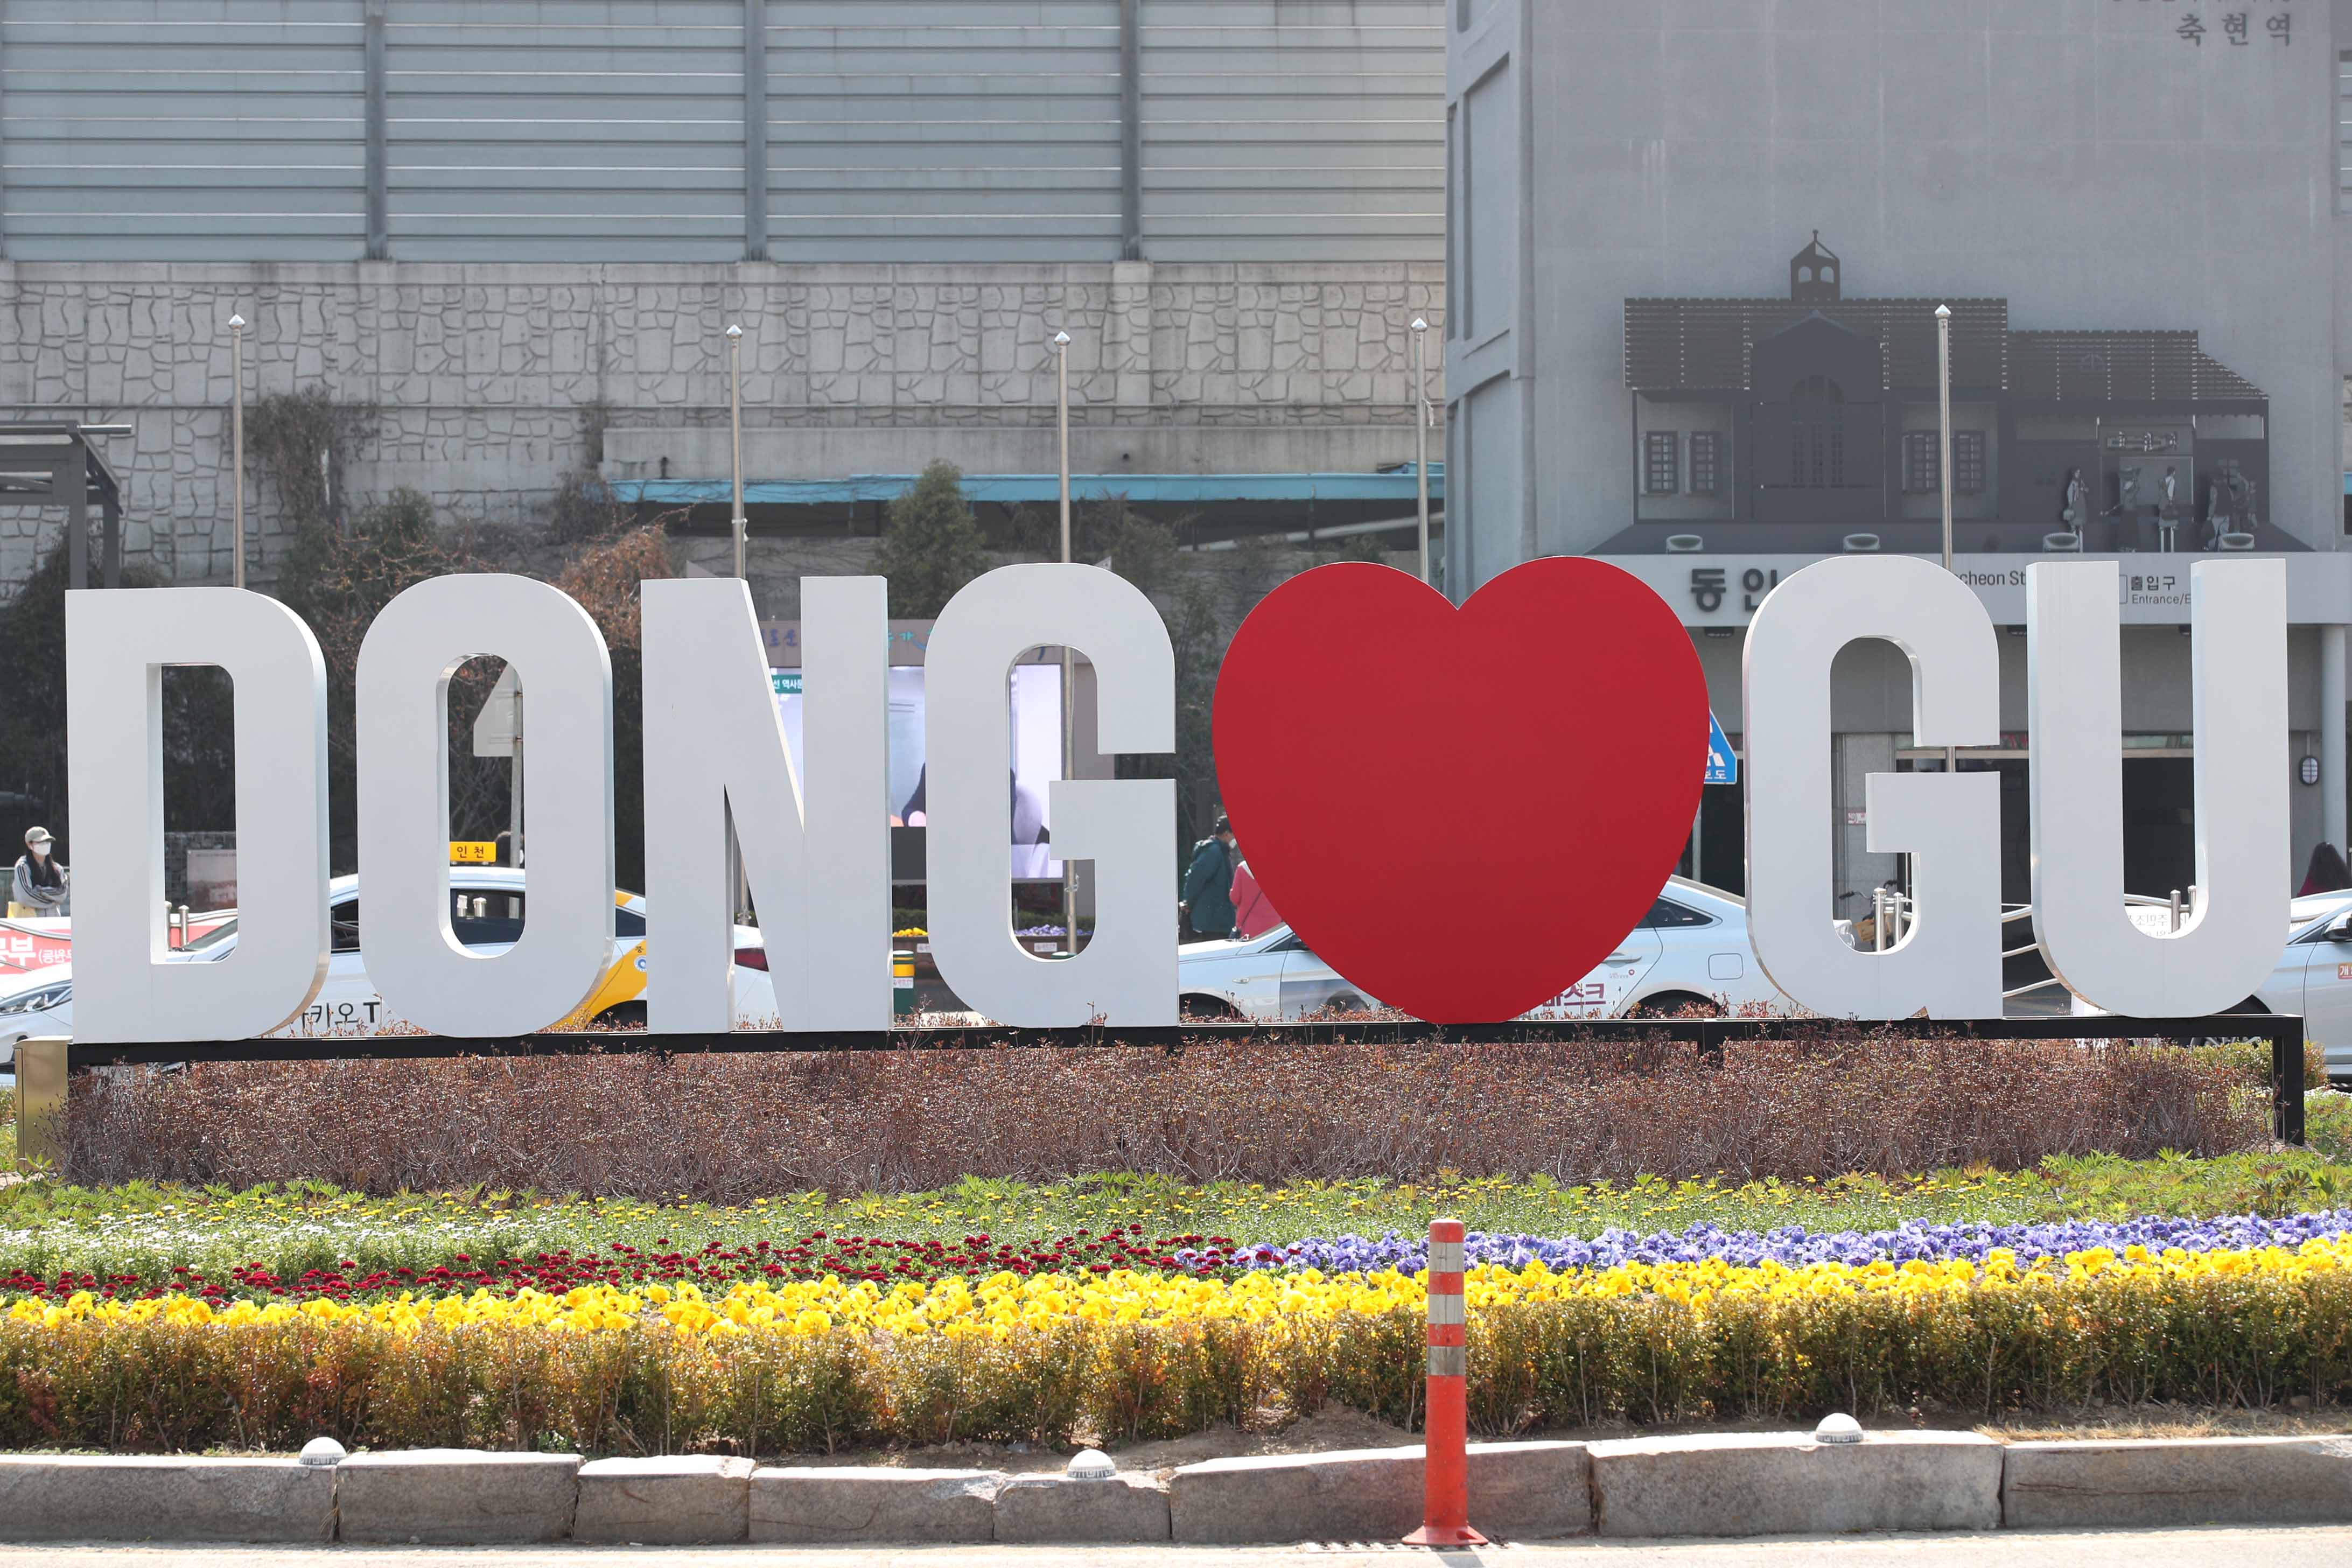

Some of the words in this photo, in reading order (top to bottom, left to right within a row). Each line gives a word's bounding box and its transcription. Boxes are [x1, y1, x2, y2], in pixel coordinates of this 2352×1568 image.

[2176, 13, 2290, 47] 축현역
[1955, 571, 2005, 585] cheon
[2131, 576, 2175, 591] 출입구
[65, 562, 1178, 1044] DONG
[1742, 555, 2291, 1020] GU
[457, 845, 484, 858] 인천
